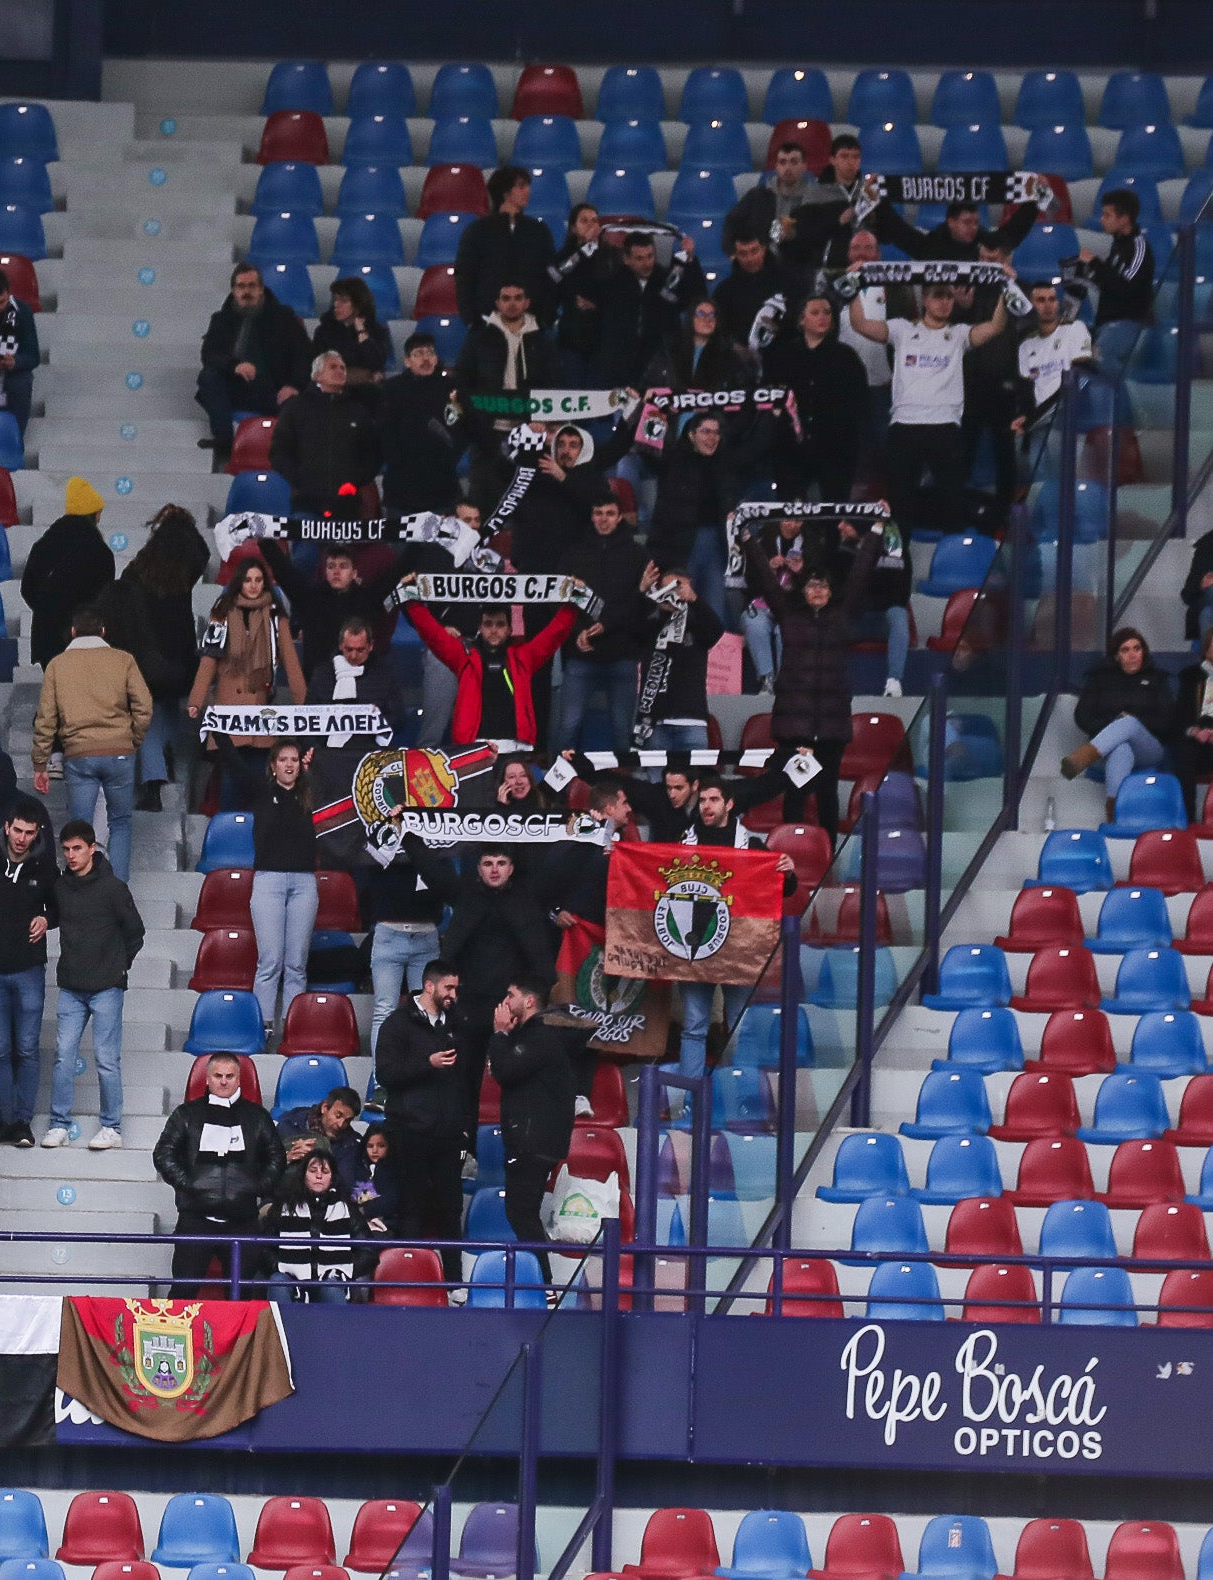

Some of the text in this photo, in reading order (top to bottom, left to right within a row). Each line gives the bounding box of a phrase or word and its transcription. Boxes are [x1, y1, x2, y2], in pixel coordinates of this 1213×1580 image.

[902, 177, 990, 201] BURGOS CF
[561, 396, 591, 412] C.F.
[754, 388, 785, 402] CF
[368, 518, 387, 540] CF
[433, 576, 558, 599] BURGOS C.F
[295, 715, 321, 732] DE
[374, 783, 391, 816] URGOS
[589, 1026, 633, 1042] RGOS
[61, 1189, 73, 1198] 13
[55, 1248, 67, 1257] 12
[840, 1324, 1108, 1446] Pepe Boscá
[953, 1426, 1104, 1460] OPTICOS
